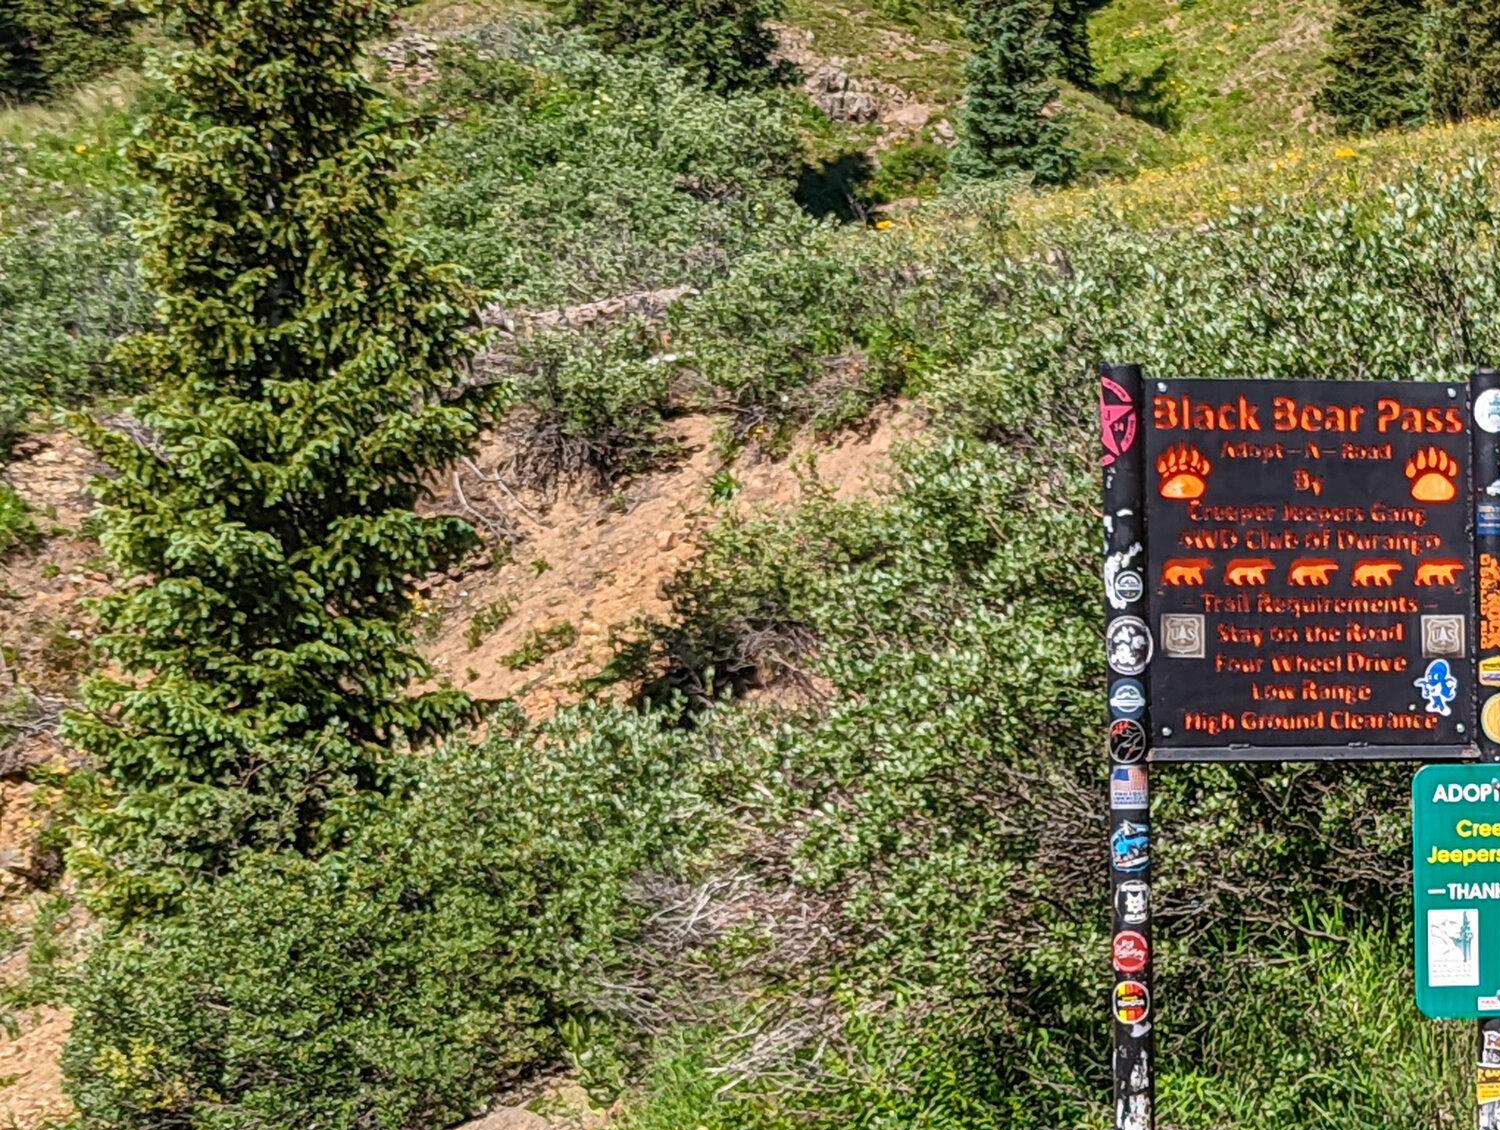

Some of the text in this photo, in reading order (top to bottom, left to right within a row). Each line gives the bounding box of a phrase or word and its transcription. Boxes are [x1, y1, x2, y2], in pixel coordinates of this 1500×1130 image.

[1152, 394, 1261, 433] Black
[1273, 396, 1365, 433] Bear
[1377, 397, 1464, 435] Pass
[1293, 468, 1325, 497] By
[1187, 502, 1427, 526] Creeper Jeepers Gang
[1244, 528, 1300, 551] Club
[1304, 528, 1331, 549] of
[1337, 527, 1442, 557] Durango
[1202, 592, 1418, 617] Trail Requirements
[1217, 622, 1405, 647] Stay on the Road
[1215, 652, 1407, 674] Four Wheel Drive
[1251, 680, 1372, 704] Low Range
[1184, 711, 1440, 736] High Ground Clearance
